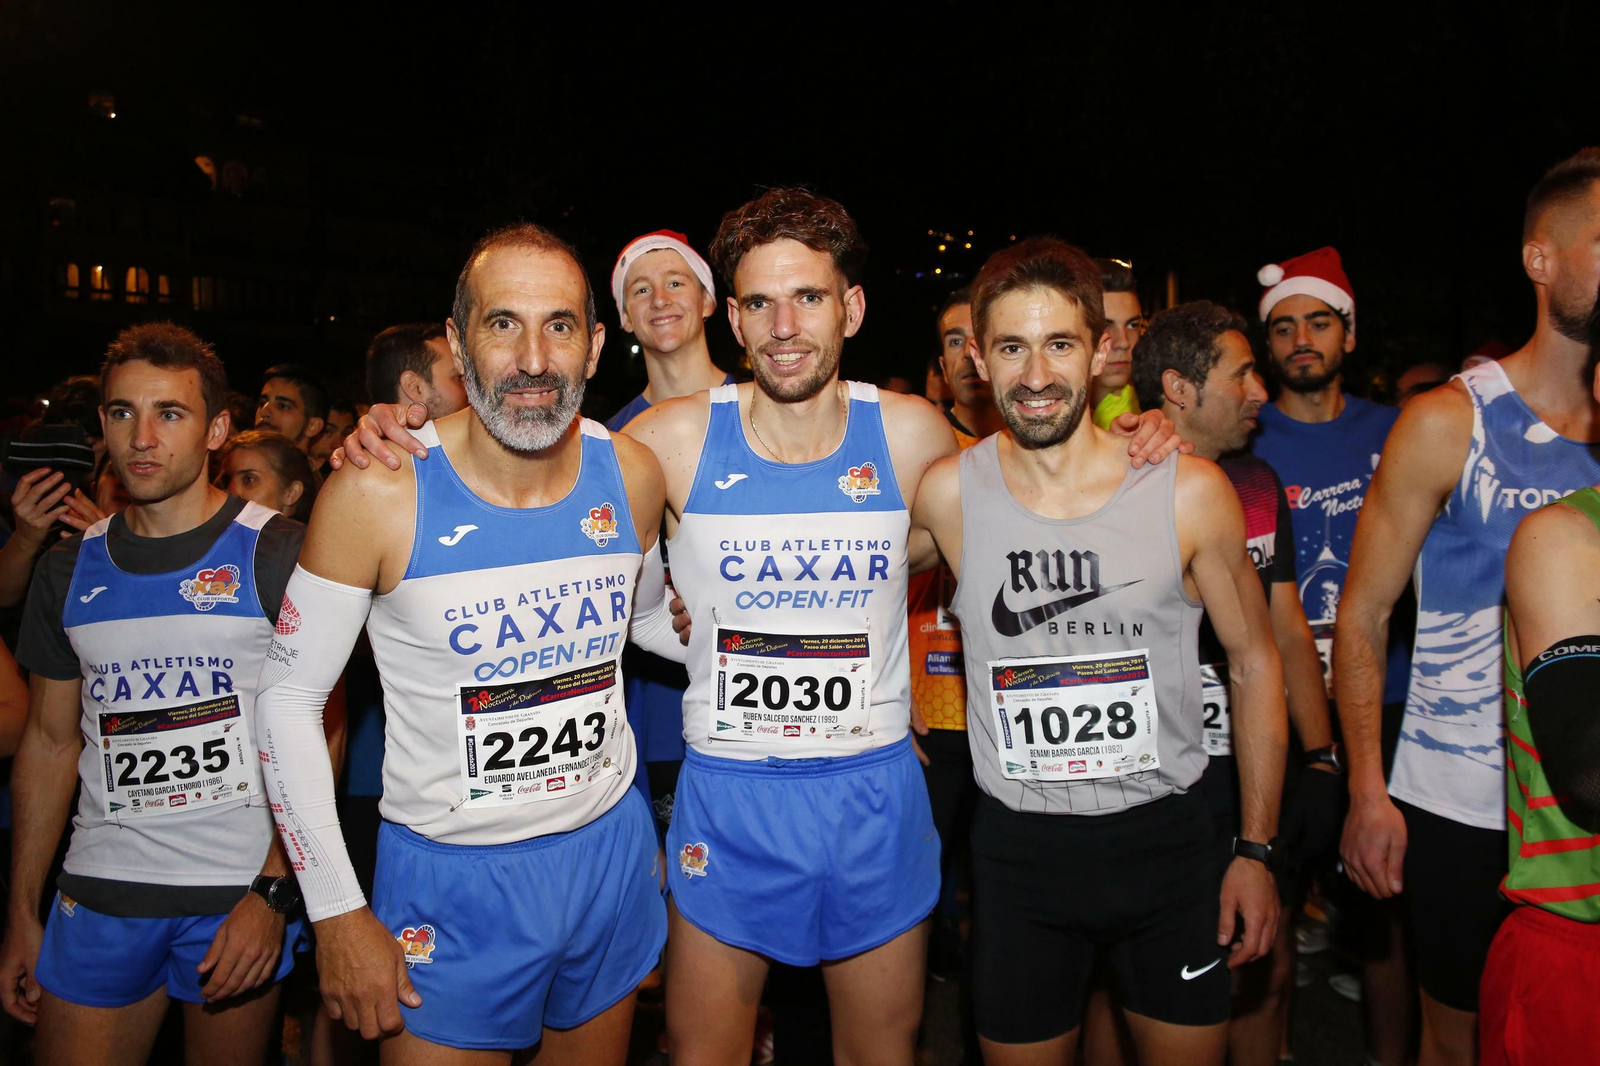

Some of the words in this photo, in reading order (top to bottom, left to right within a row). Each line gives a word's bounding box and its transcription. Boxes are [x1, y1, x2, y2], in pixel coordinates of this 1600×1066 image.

[1298, 478, 1362, 509] Carrera
[1501, 488, 1576, 509] TOD
[720, 540, 771, 551] CLUB
[782, 540, 891, 550] ATLETISMO
[720, 554, 889, 582] CAXAR
[444, 598, 506, 622] CLUB
[517, 574, 626, 606] ATLETISMO
[448, 591, 626, 656] CAXAR
[1049, 621, 1143, 636] BERLIN
[723, 634, 741, 652] 28
[732, 642, 766, 652] Nocturna
[90, 662, 121, 674] CLUB
[131, 656, 234, 670] ATLETISMO
[90, 671, 234, 702] CAXAR
[996, 669, 1015, 688] 28
[1012, 668, 1034, 679] Carrera
[1004, 674, 1037, 688] Nocturna
[468, 690, 490, 712] 28
[489, 688, 514, 700] Carrera
[479, 693, 517, 710] Nocturna
[730, 672, 851, 712] 2030
[197, 702, 221, 711] diciembre
[214, 705, 235, 713] Granada
[743, 712, 762, 721] RUBEN
[763, 714, 789, 722] SALCEDO
[790, 715, 816, 723] SANCHEZ
[1014, 701, 1137, 745] 1028
[482, 712, 606, 771] 2243
[1030, 749, 1050, 757] BENAMI
[1052, 748, 1076, 757] BARROS
[1077, 746, 1100, 756] GARCIA
[115, 738, 229, 786] 2235
[484, 773, 515, 784] EDUARDO
[517, 766, 557, 781] AVELLANEDA
[558, 758, 589, 773] FERNANDEZ
[128, 789, 154, 798] CAYETANO
[155, 786, 176, 795] GARCIA
[177, 781, 201, 792] TENORIO
[518, 783, 542, 794] Coca-Cola
